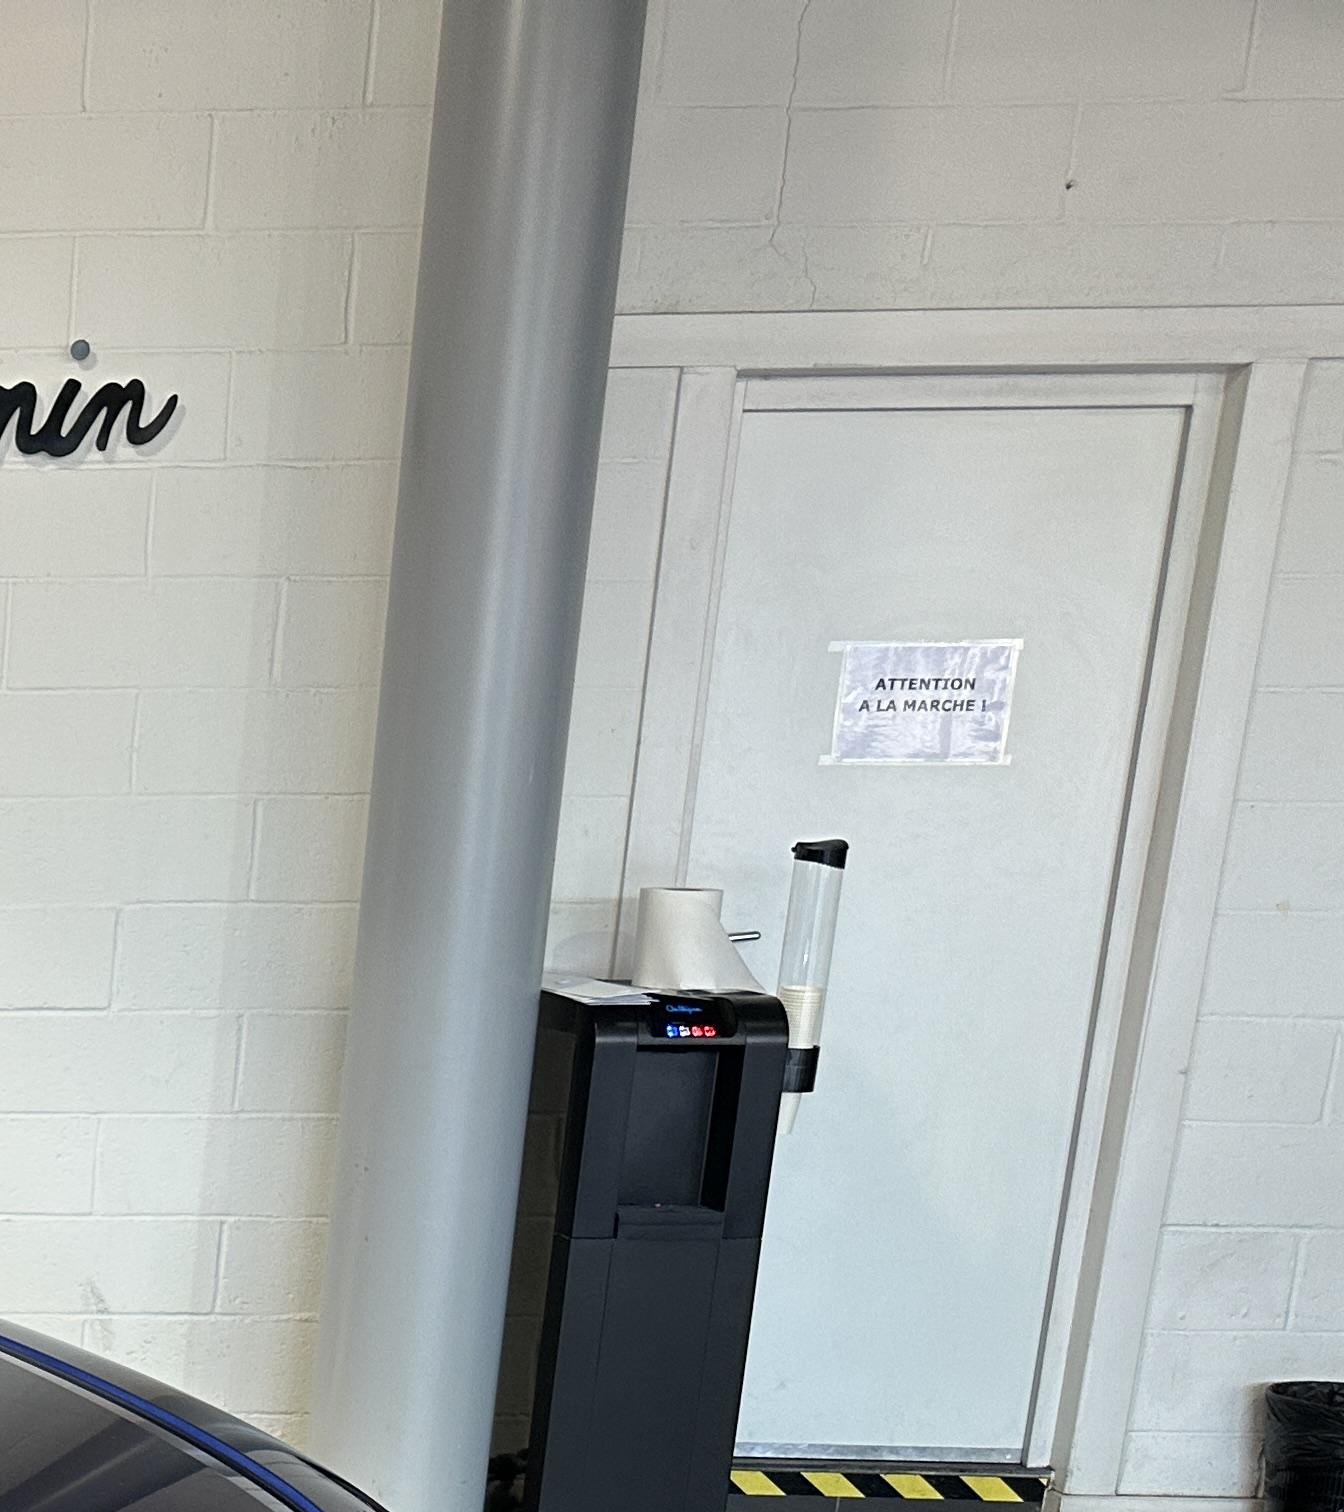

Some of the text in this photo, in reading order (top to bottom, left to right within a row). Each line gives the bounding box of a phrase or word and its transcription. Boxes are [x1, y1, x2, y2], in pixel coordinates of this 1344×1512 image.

[875, 678, 976, 691] ATTENTION
[859, 700, 870, 712] A
[877, 700, 897, 712] LA
[903, 699, 976, 712] MARCHE
